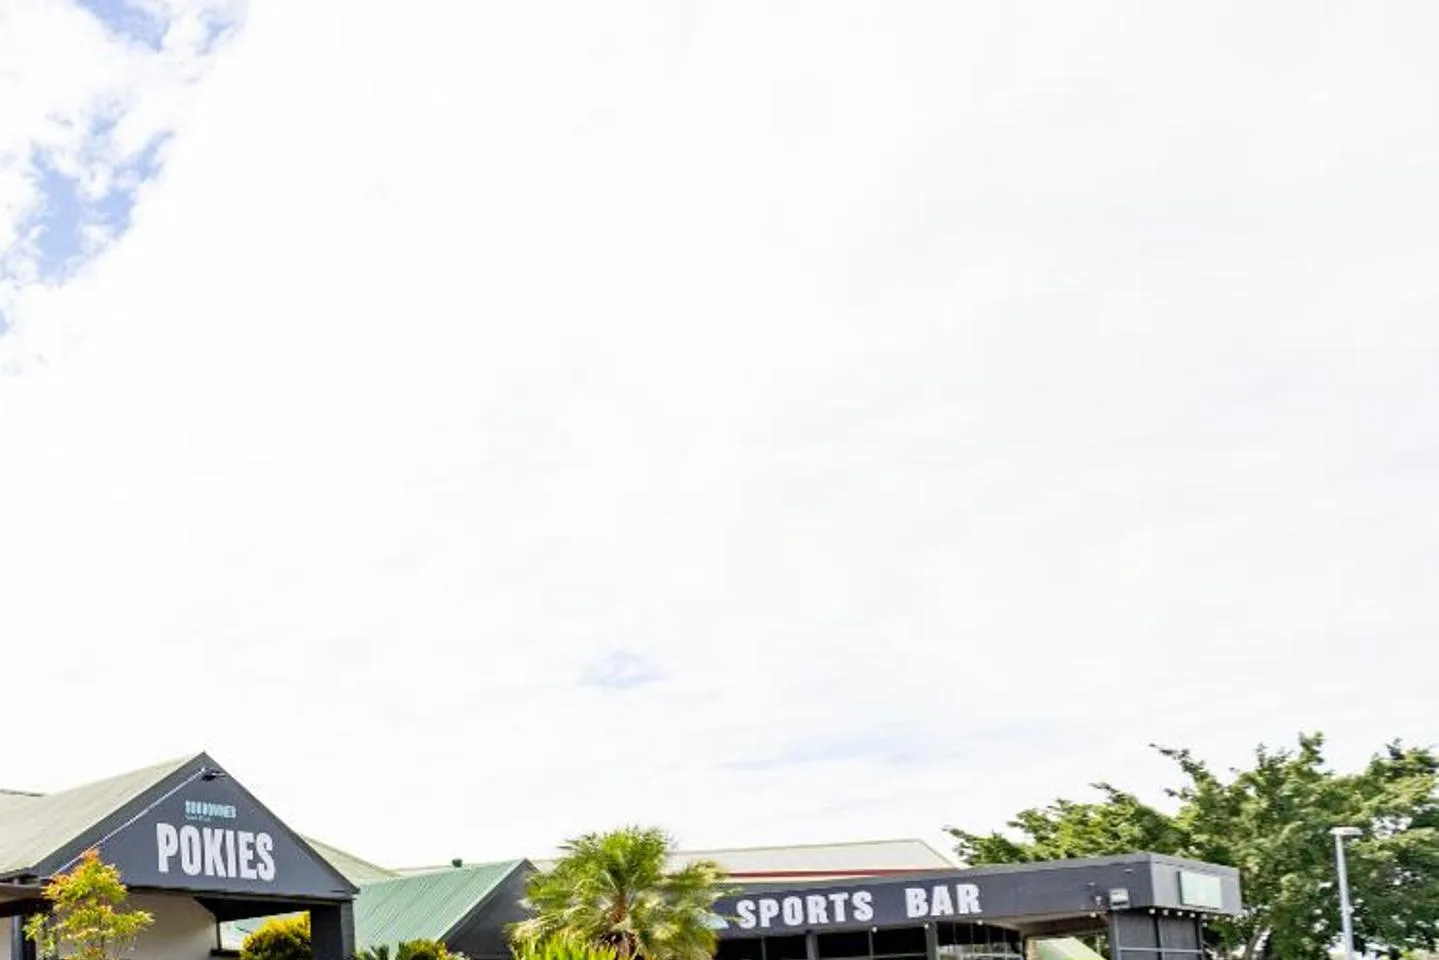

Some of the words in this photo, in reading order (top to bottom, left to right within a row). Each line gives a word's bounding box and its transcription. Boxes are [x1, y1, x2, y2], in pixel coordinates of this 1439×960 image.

[156, 822, 276, 882] POKIES
[735, 890, 874, 929] SPORTS
[904, 883, 983, 919] BAR
